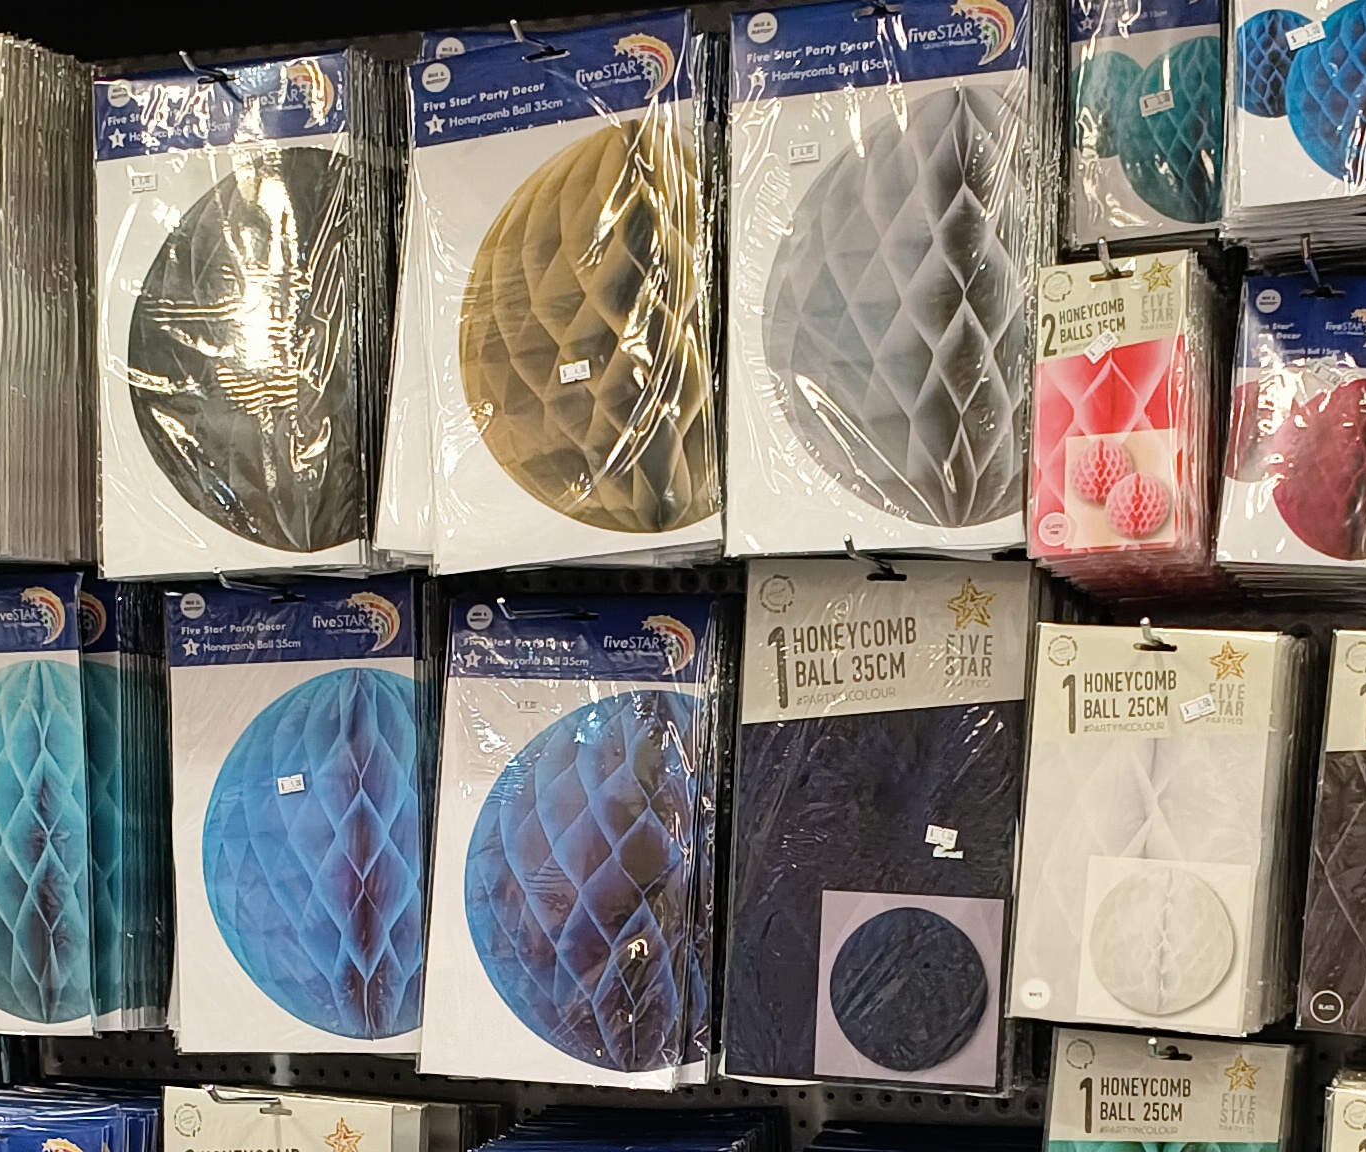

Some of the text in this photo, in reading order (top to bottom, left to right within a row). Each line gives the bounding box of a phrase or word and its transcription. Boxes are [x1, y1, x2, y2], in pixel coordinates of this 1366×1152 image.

[423, 99, 447, 113] Five
[479, 88, 509, 105] Party
[511, 81, 545, 98] Decor
[449, 97, 564, 127] Honeycomb Ball 35cm
[1142, 293, 1176, 311] FIVE
[1142, 308, 1175, 324] STAR
[1042, 300, 1124, 357] 2 HONEYCOMB
[1060, 318, 1126, 345] BALLS 15CM
[767, 616, 917, 709] 1 HONEYCOMB
[795, 651, 906, 688] BALL 35CM
[1062, 669, 1177, 734] 1 HONEYCOMB
[1083, 695, 1169, 720] BALL 25CM
[1079, 1077, 1192, 1135] 1 HONEYCOMB
[1100, 1101, 1184, 1122] BALL 25CM
